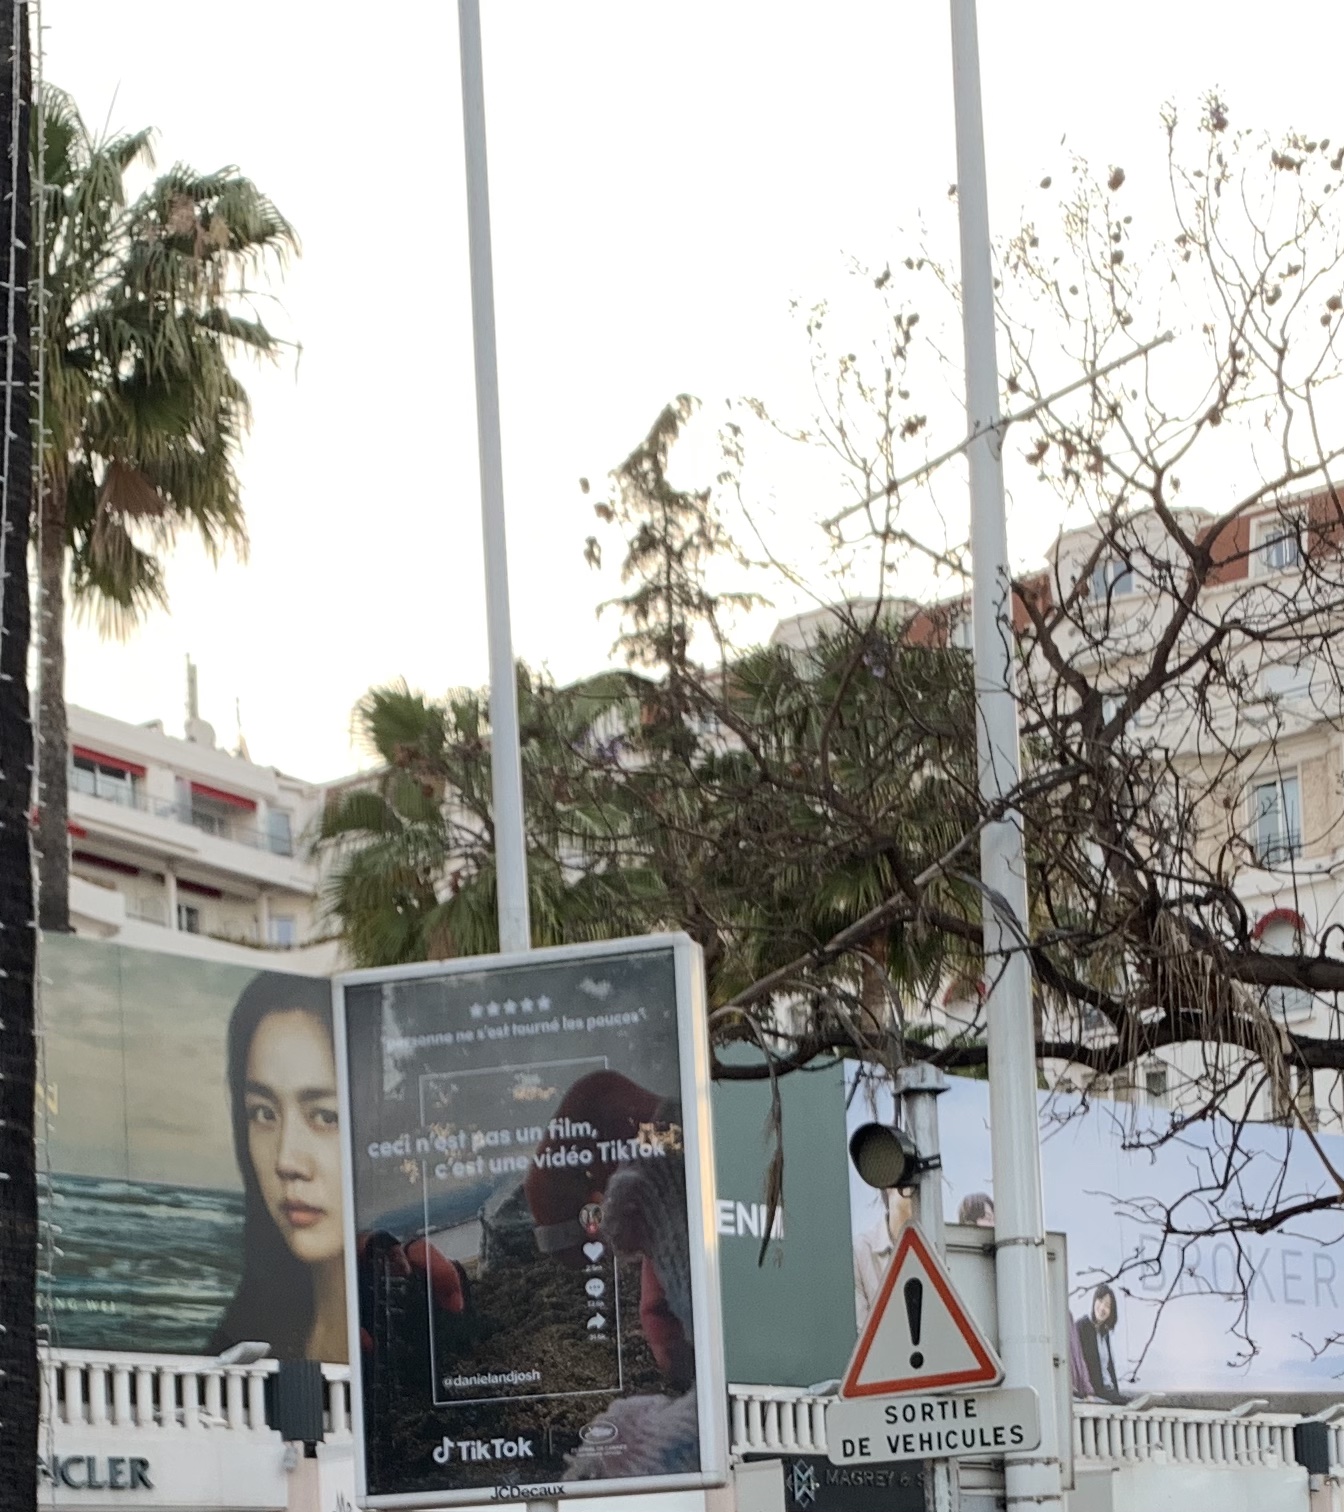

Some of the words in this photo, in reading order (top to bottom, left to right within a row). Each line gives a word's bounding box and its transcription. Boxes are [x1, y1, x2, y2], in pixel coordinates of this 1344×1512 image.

[368, 1133, 411, 1158] ceci
[416, 1130, 466, 1152] n'est
[471, 1129, 512, 1153] pas
[515, 1126, 543, 1143] un
[548, 1115, 597, 1140] film,
[435, 1157, 485, 1180] c'est
[489, 1155, 530, 1173] une
[533, 1144, 593, 1170] vidéo
[596, 1136, 667, 1163] TikTok
[1140, 1232, 1339, 1309] BROKER
[443, 1369, 541, 1388] @danielandjosh
[885, 1399, 977, 1425] SORTIE
[457, 1437, 534, 1462] TikTok
[842, 1438, 871, 1458] DE
[887, 1425, 1024, 1454] VEHICULES
[37, 1454, 155, 1489] NCLER
[825, 1468, 894, 1487] MAGREY
[490, 1485, 565, 1500] JCDecaux
